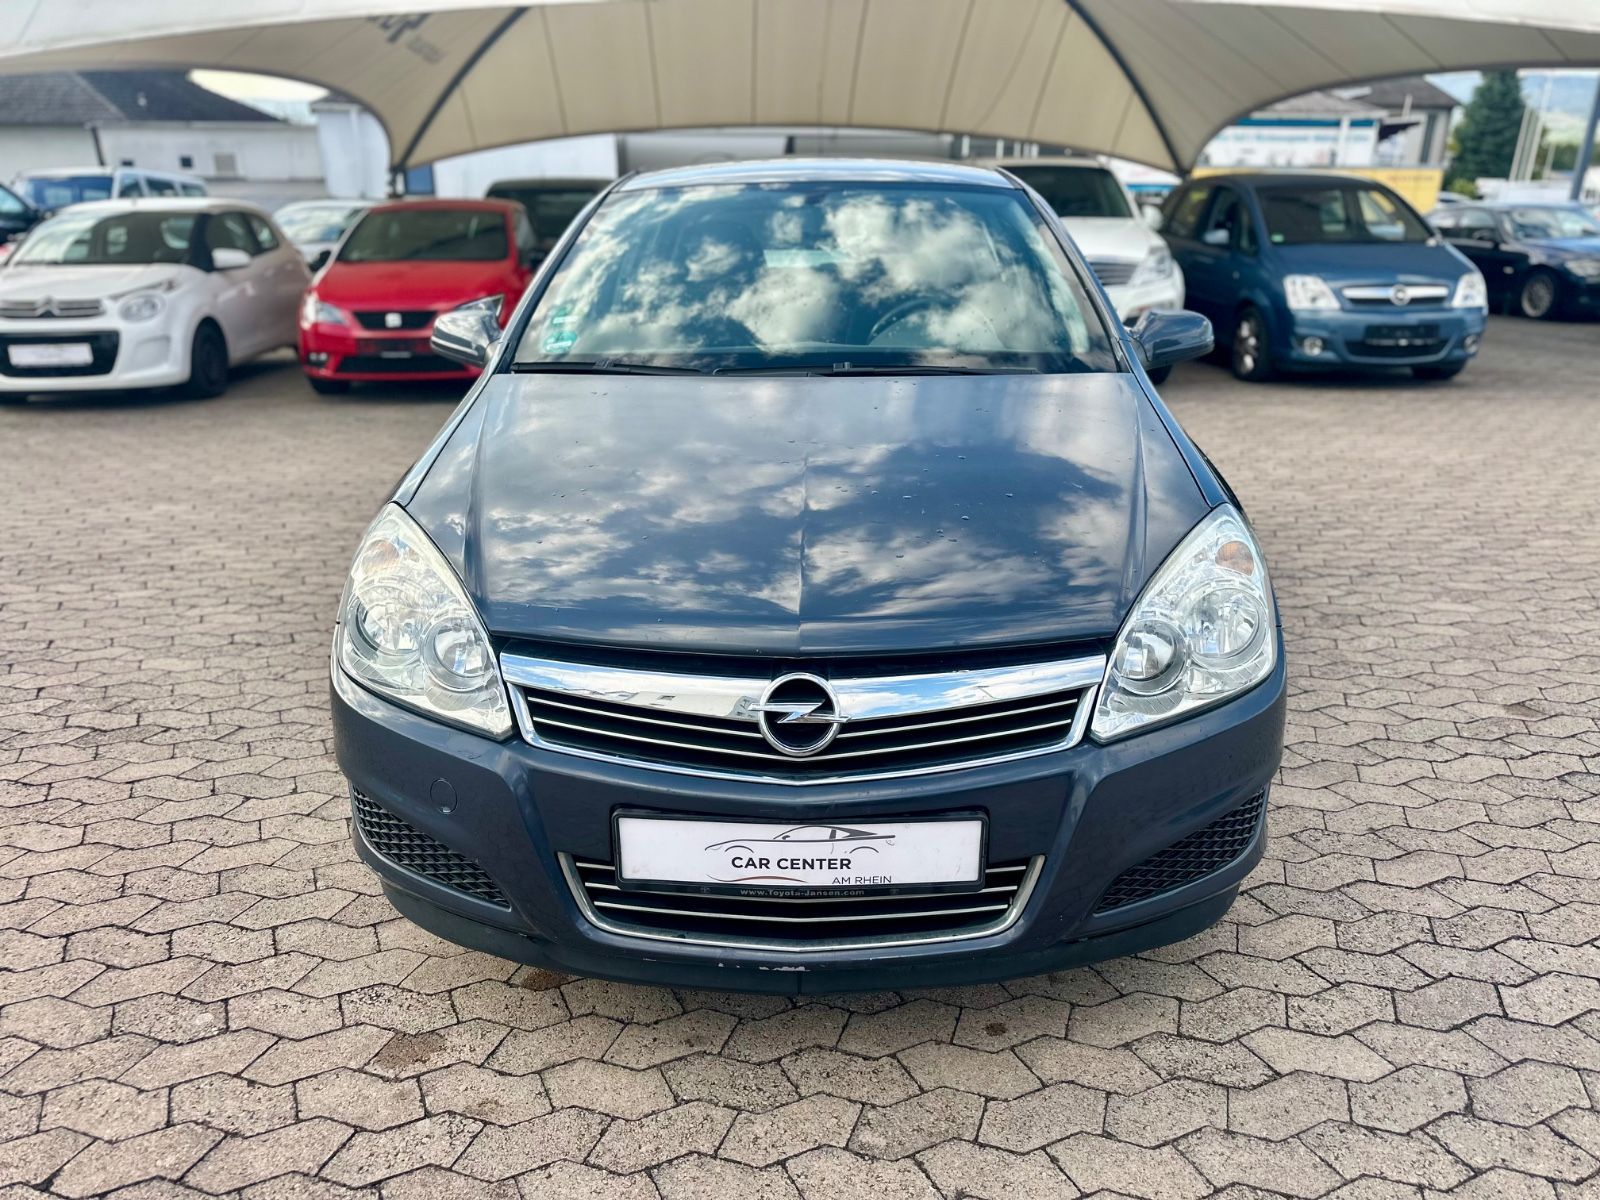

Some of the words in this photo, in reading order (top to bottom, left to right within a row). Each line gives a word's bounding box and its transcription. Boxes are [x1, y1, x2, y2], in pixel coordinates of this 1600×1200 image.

[731, 856, 771, 869] CAR
[776, 858, 852, 870] CENTER
[831, 876, 851, 885] AM
[854, 875, 892, 884] RHEIN
[740, 889, 865, 897] www.Toyota-Jansen.com
